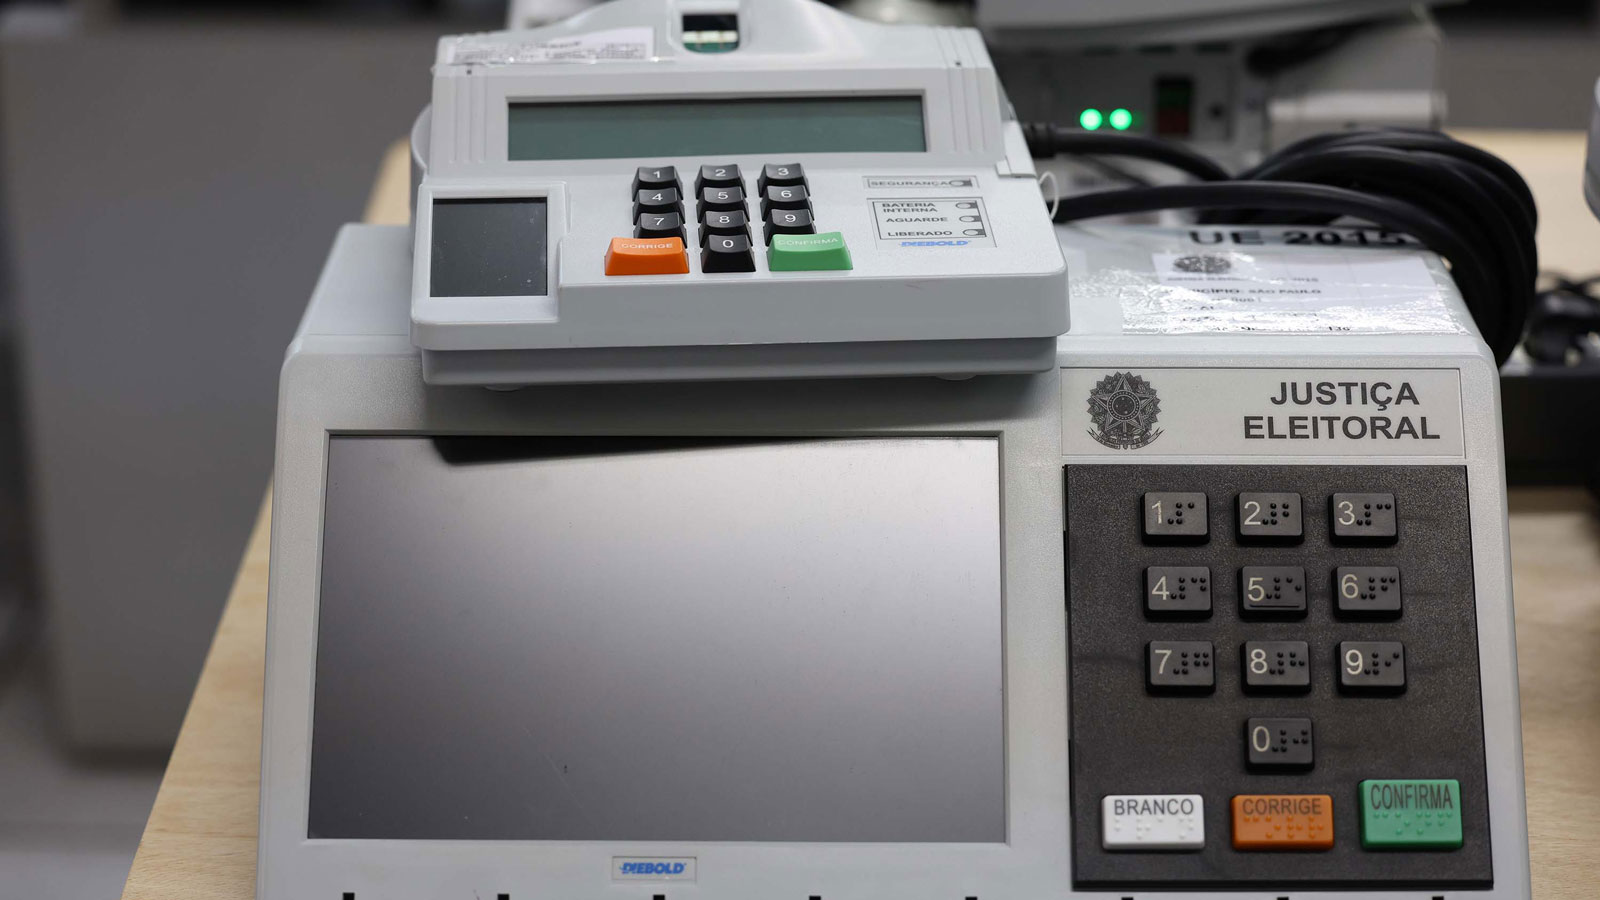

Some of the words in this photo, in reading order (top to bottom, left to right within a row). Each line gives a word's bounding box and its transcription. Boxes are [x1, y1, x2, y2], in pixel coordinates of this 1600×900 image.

[653, 171, 661, 179] 1
[715, 169, 726, 177] 2
[778, 168, 789, 176] 3
[871, 180, 950, 188] SEGURANÇA
[652, 193, 663, 201] 4
[718, 192, 729, 200] 5
[781, 190, 792, 198] 6
[654, 217, 665, 226] 7
[719, 215, 730, 224] 8
[785, 214, 797, 222] 9
[621, 242, 674, 250] CORRIGE
[722, 239, 734, 248] 0
[777, 237, 839, 246] CONFIRMA
[1188, 230, 1264, 245] UE
[1282, 230, 1408, 246] 2015
[1270, 382, 1420, 411] JUSTIÇA
[1243, 416, 1440, 439] ELEITORAL
[1151, 501, 1163, 524] 1
[1244, 501, 1262, 525] 2
[1338, 501, 1356, 526] 3
[1151, 576, 1170, 600] 4
[1247, 577, 1265, 602] 5
[1341, 573, 1359, 599] 6
[1154, 649, 1172, 674] 7
[1250, 649, 1268, 674] 8
[1345, 649, 1363, 675] 9
[1252, 725, 1270, 752] 0
[1370, 784, 1454, 810] CONFIRMA
[1114, 798, 1194, 816] BRANCO
[1242, 798, 1323, 816] CORRIGE
[619, 862, 685, 875] DIEBOLD
